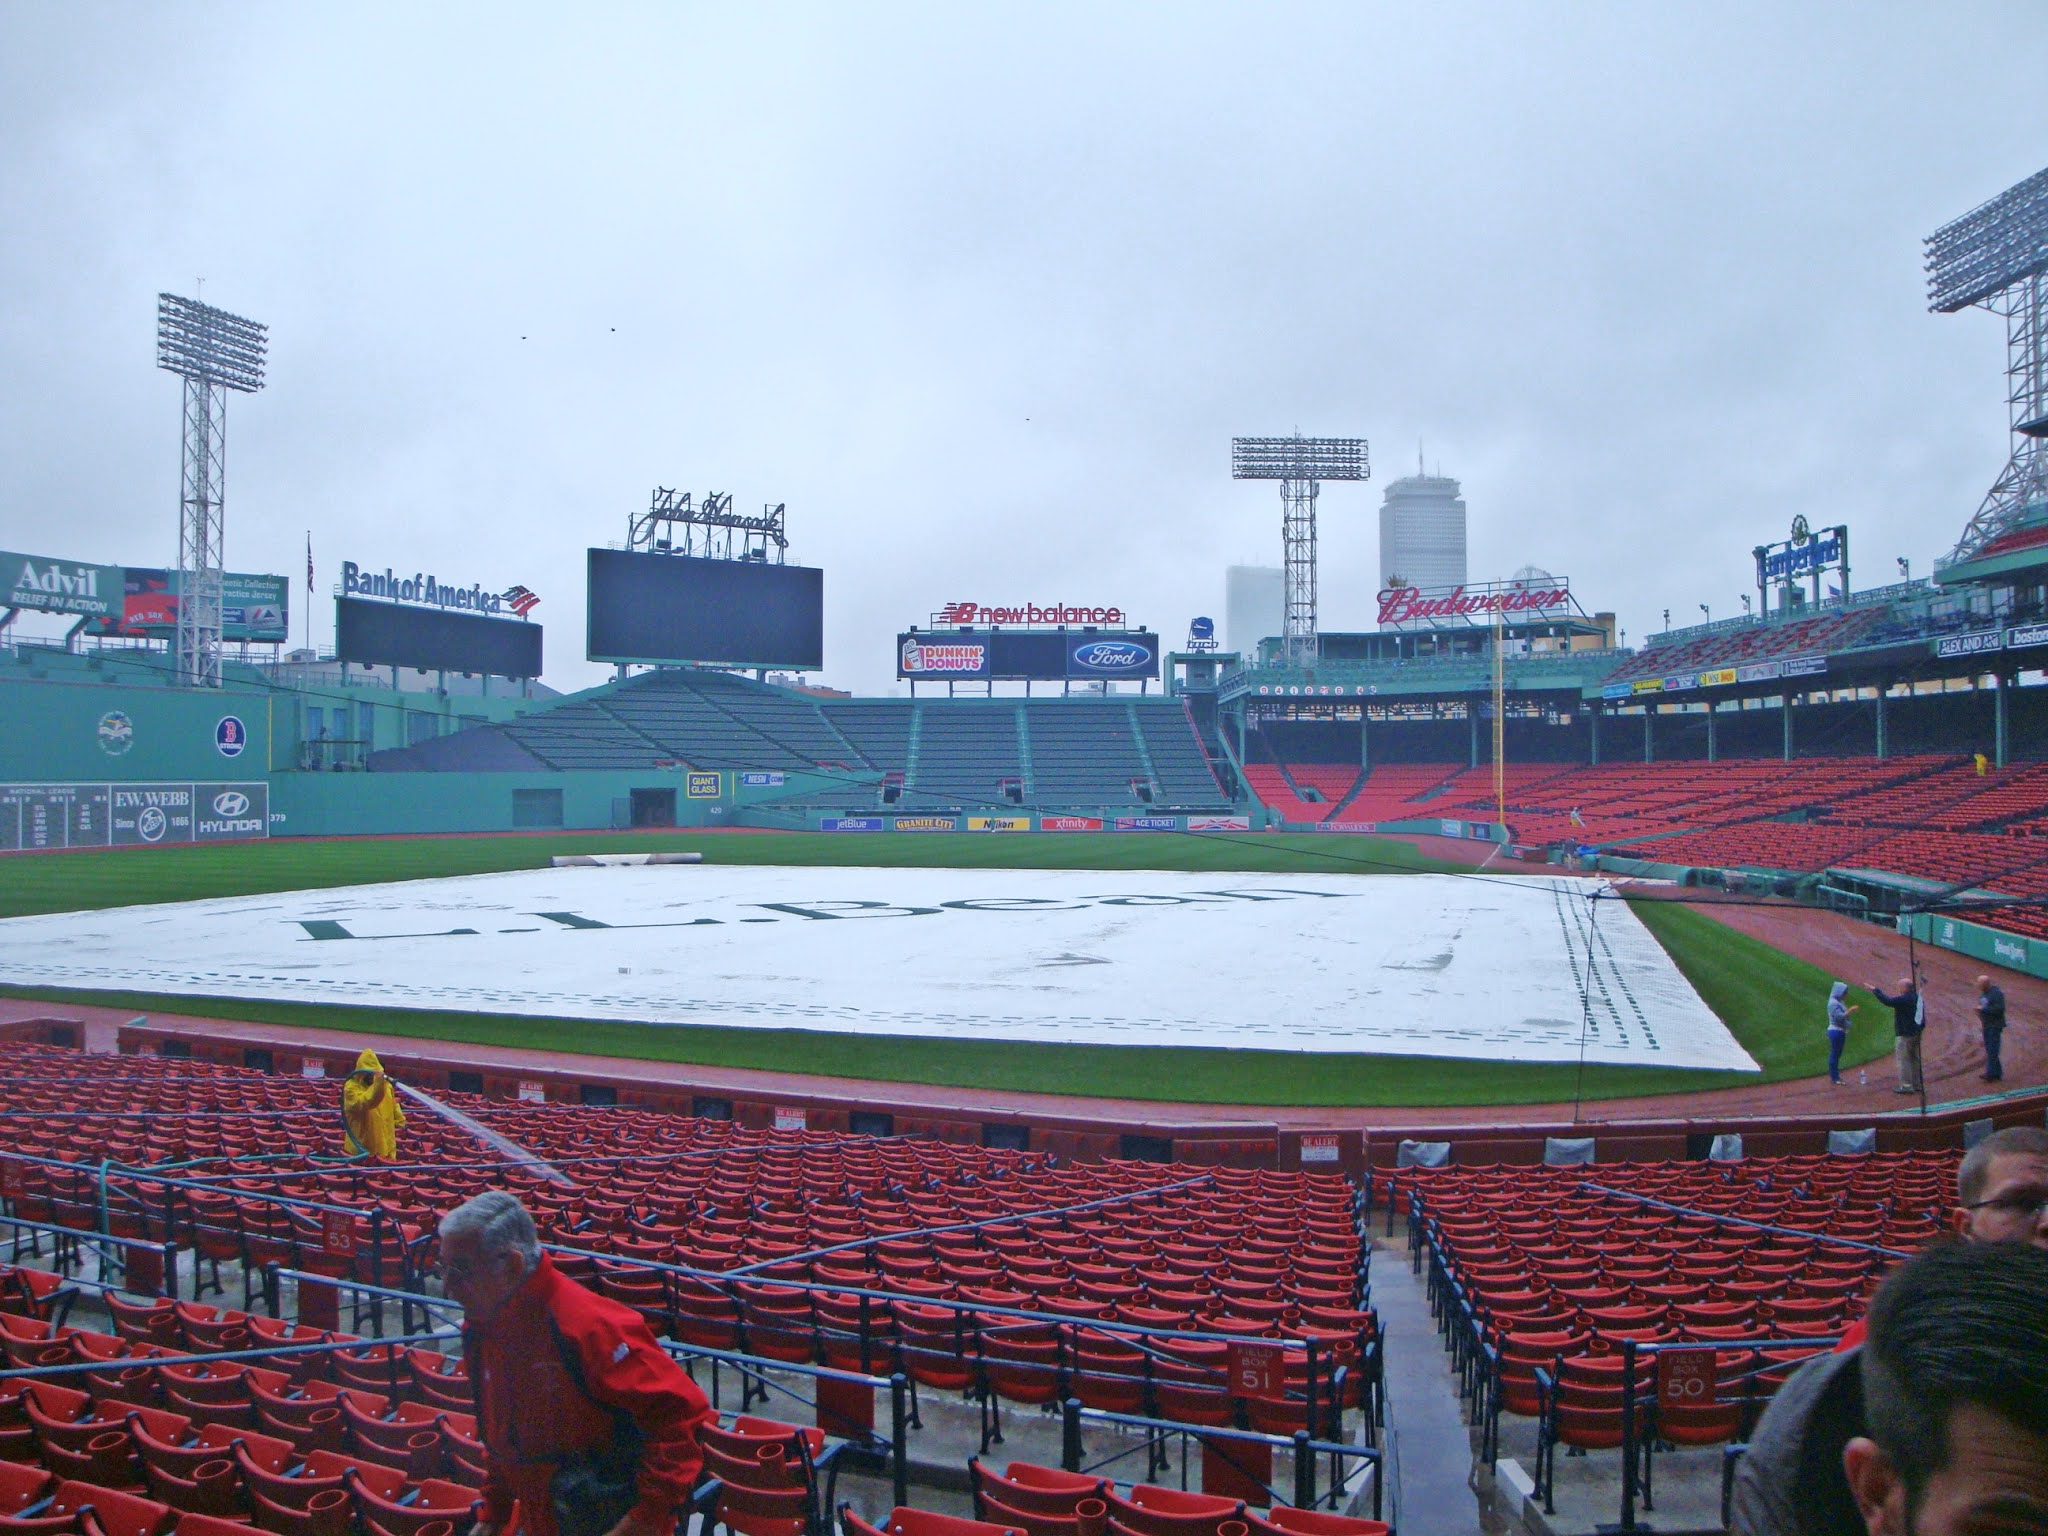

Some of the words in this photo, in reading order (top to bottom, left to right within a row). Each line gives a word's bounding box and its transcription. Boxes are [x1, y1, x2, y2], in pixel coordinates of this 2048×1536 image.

[15, 561, 98, 597] Advil
[343, 561, 400, 602] Bank
[401, 573, 423, 601] of
[425, 575, 501, 613] America
[251, 590, 278, 601] Jersey
[12, 591, 49, 606] RELIEF
[49, 596, 64, 608] IN
[66, 599, 108, 613] ACTION
[1377, 582, 1568, 624] Budweiser
[979, 607, 1025, 624] new
[1027, 602, 1121, 624] balance
[1941, 639, 1961, 654] ALEX
[1962, 635, 1982, 652] AND
[1983, 633, 1999, 649] ANI
[925, 647, 983, 657] DUNKIN'
[1088, 645, 1136, 666] Ford
[925, 658, 980, 669] DONUTS
[225, 721, 237, 742] B
[692, 777, 715, 785] GIANT
[691, 786, 716, 794] GLASS
[115, 791, 145, 807] F.W.
[145, 791, 189, 806] WEBB
[115, 818, 135, 829] Since
[270, 814, 286, 822] 379
[896, 819, 933, 829] GRANITE
[935, 818, 954, 829] CITY
[1135, 819, 1150, 827] ACE
[1150, 819, 1175, 827] TICKET
[200, 819, 262, 833] HYUNDAI
[836, 819, 867, 830] jetBlue
[983, 820, 1014, 829] Nikon
[1056, 820, 1087, 830] xfinity
[1314, 1137, 1336, 1146] ALERT
[329, 1231, 350, 1249] 53
[1242, 1358, 1268, 1367] BOX
[1242, 1370, 1269, 1389] 51
[1667, 1378, 1704, 1396] 50
